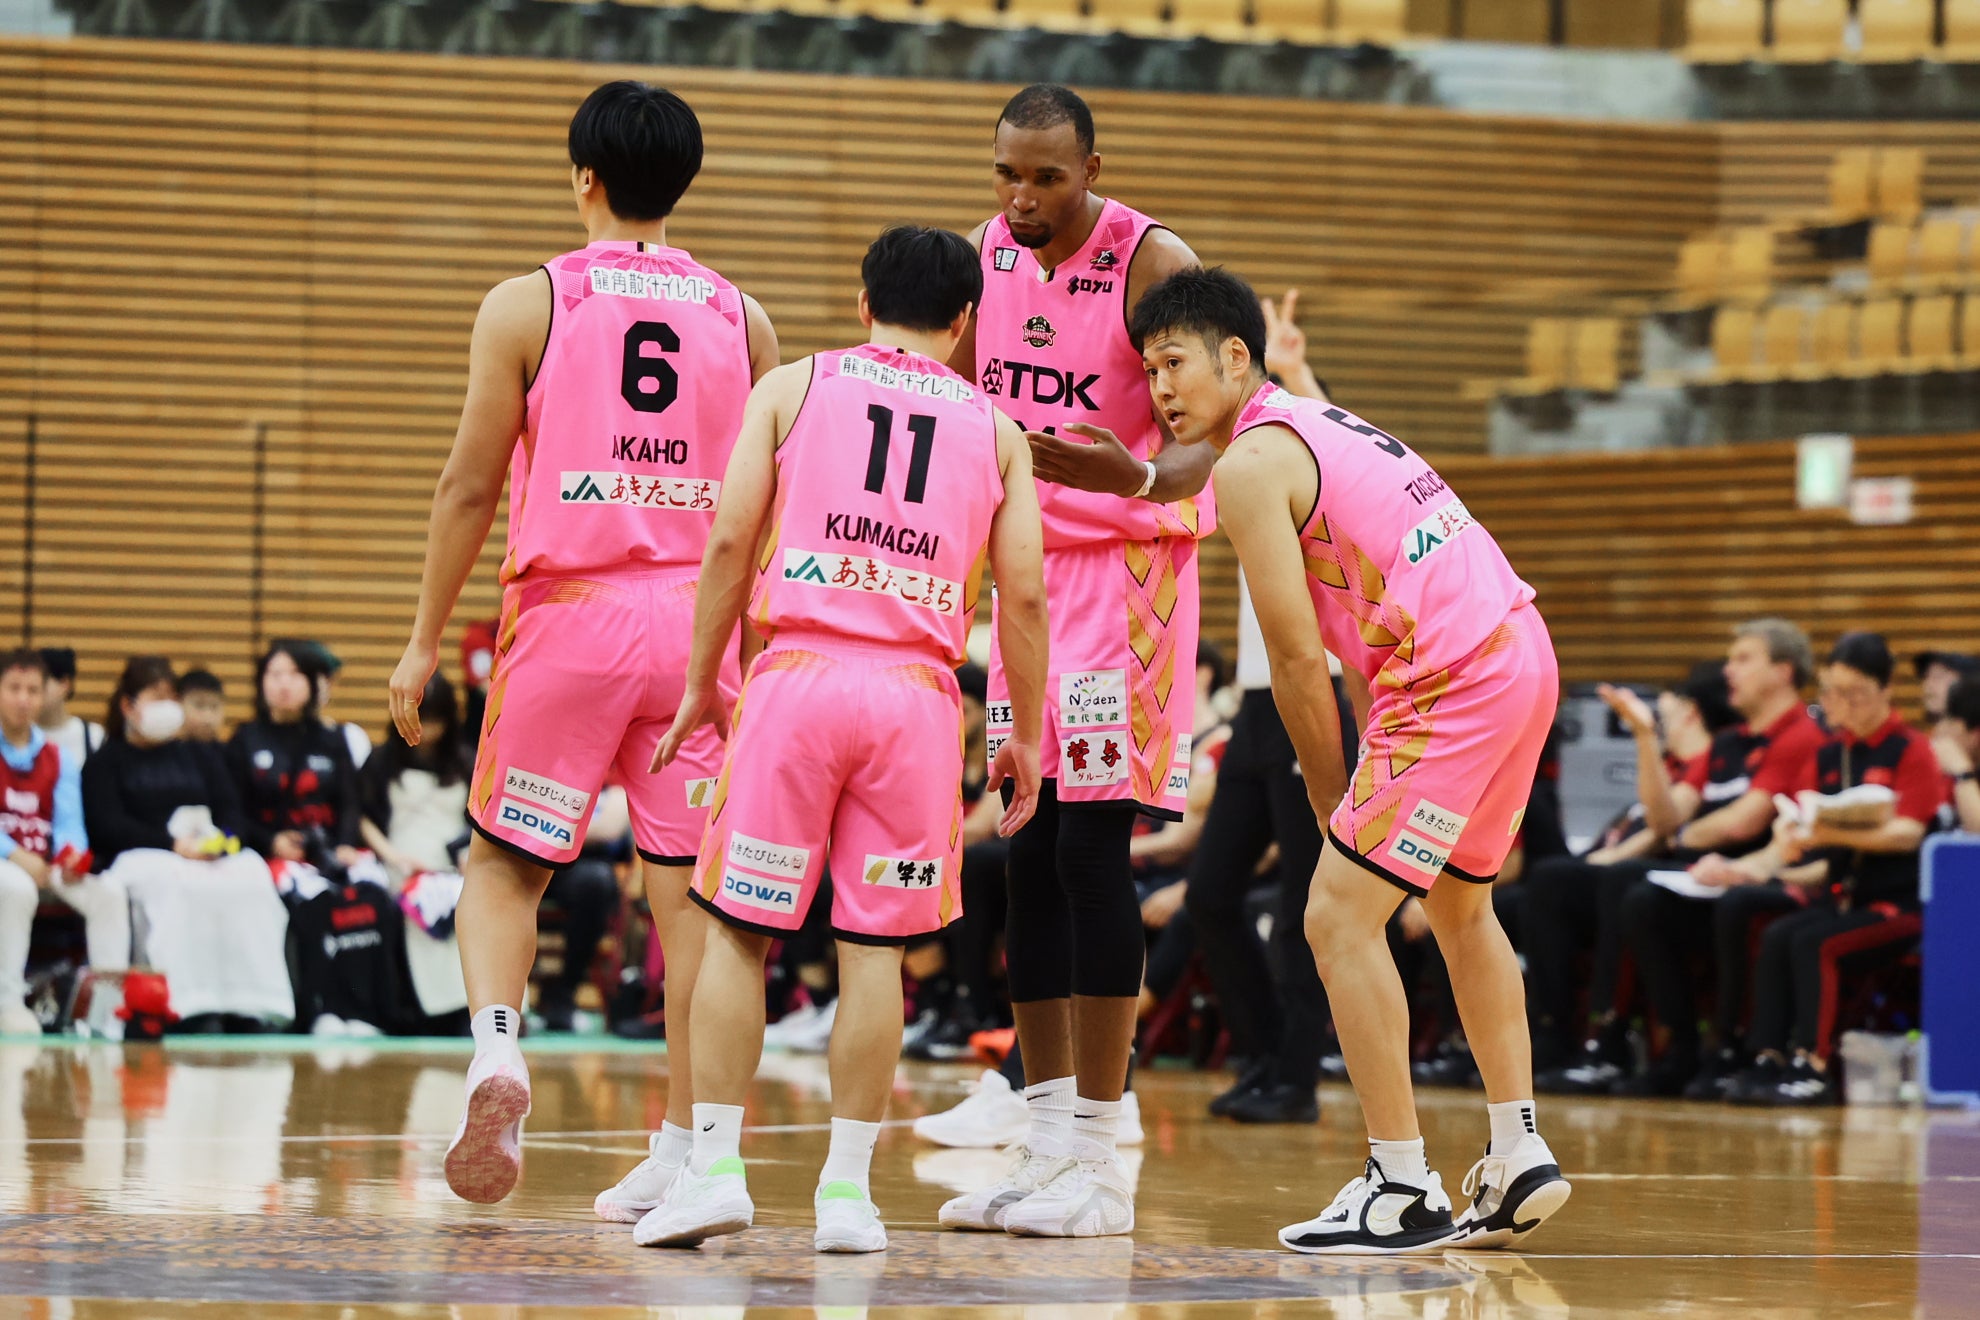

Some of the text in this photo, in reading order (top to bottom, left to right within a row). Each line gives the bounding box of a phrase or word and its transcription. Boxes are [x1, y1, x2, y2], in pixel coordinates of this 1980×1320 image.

[593, 269, 712, 301] 龍角散ダイレクト
[621, 320, 681, 414] 6
[1003, 361, 1101, 411] TDK
[612, 434, 688, 465] AKAHO
[864, 403, 937, 504] 11
[1321, 408, 1407, 459] 5
[825, 513, 939, 561] KUMAGAI
[502, 806, 571, 843] DOWA
[724, 876, 792, 905] DOWA
